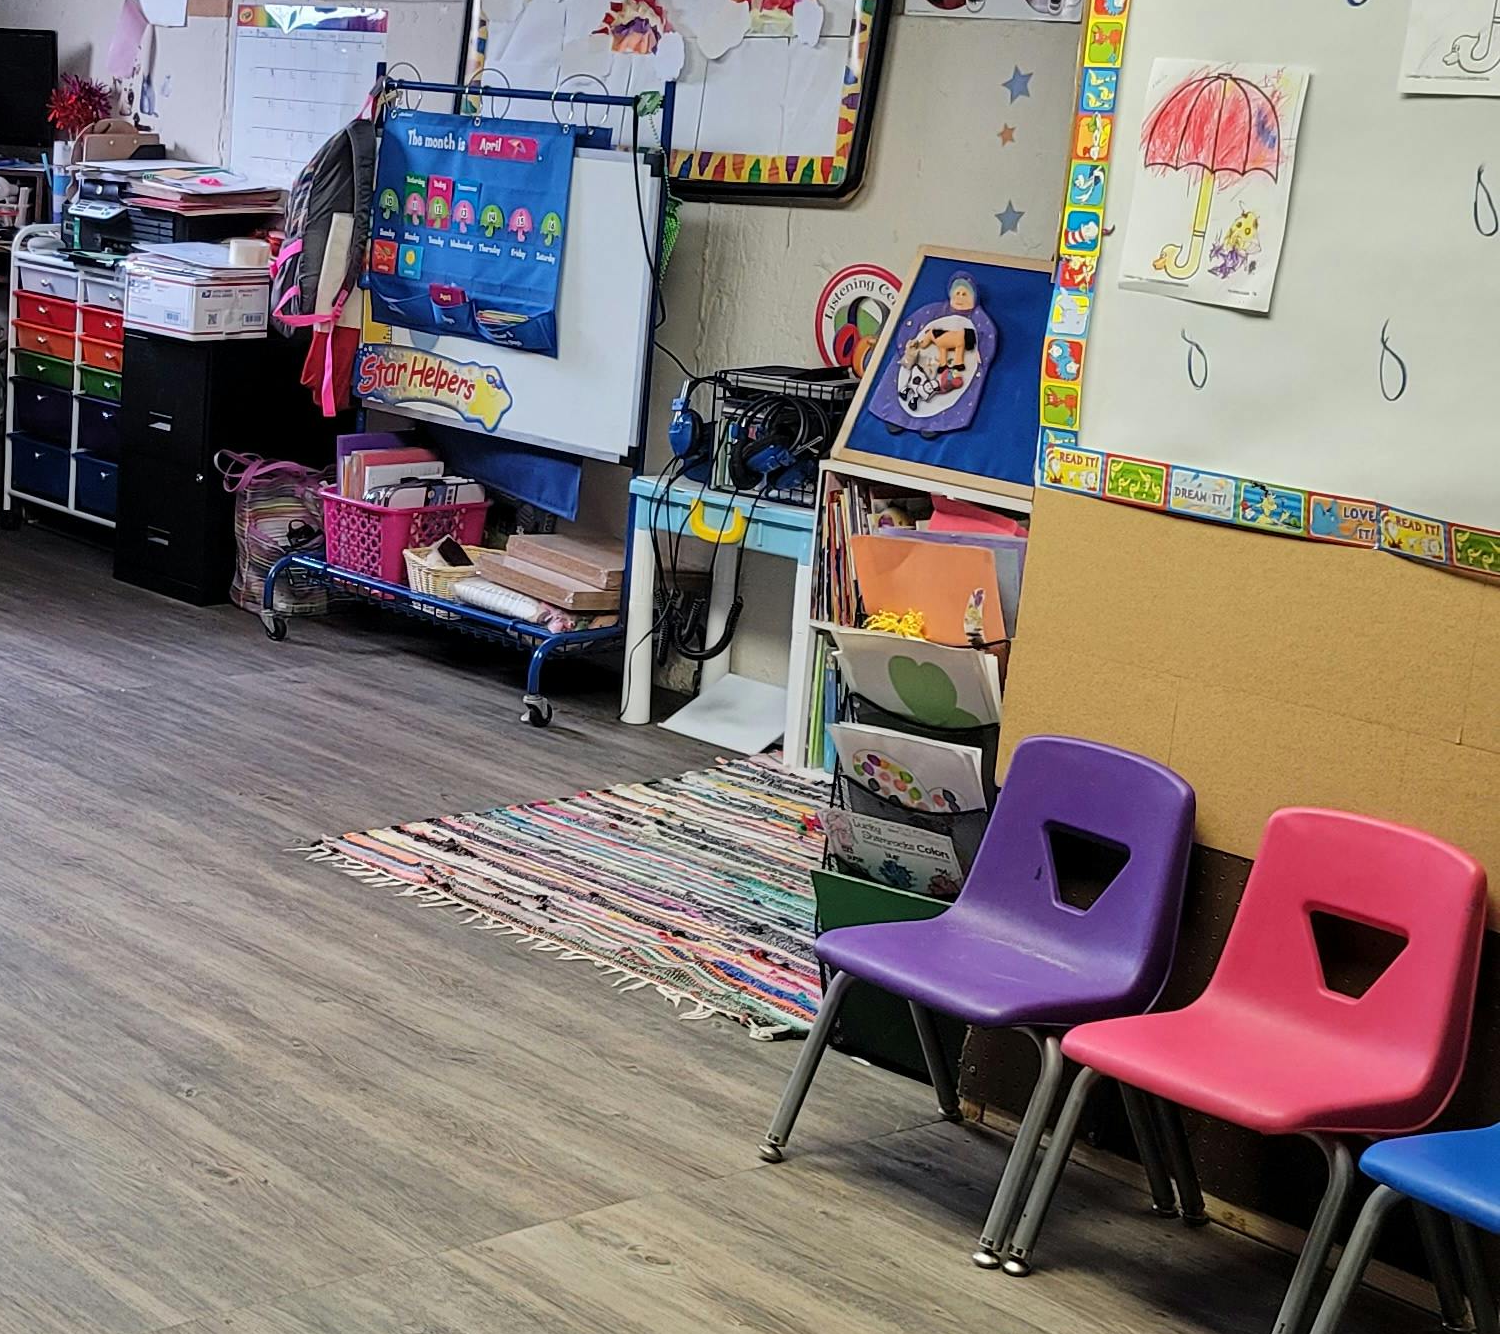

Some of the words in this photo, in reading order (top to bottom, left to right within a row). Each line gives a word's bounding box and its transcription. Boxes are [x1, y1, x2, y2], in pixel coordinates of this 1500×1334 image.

[408, 129, 424, 147] The
[424, 133, 455, 150] month
[457, 139, 466, 152] is
[479, 138, 502, 153] April
[478, 243, 501, 257] Thursday
[510, 247, 527, 261] Friday
[535, 251, 556, 266] Saturday
[824, 277, 876, 320] Listening
[358, 355, 408, 394] Star
[408, 355, 476, 401] Helpers
[1059, 451, 1084, 466] READ
[1085, 455, 1101, 468] IT!
[1174, 486, 1207, 503] DREAM
[1211, 493, 1227, 506] IT!
[1343, 506, 1376, 523] LOVE
[1358, 528, 1375, 541] IT!
[1394, 515, 1422, 533] READ
[1424, 521, 1441, 537] IT!
[916, 844, 951, 861] Colors
